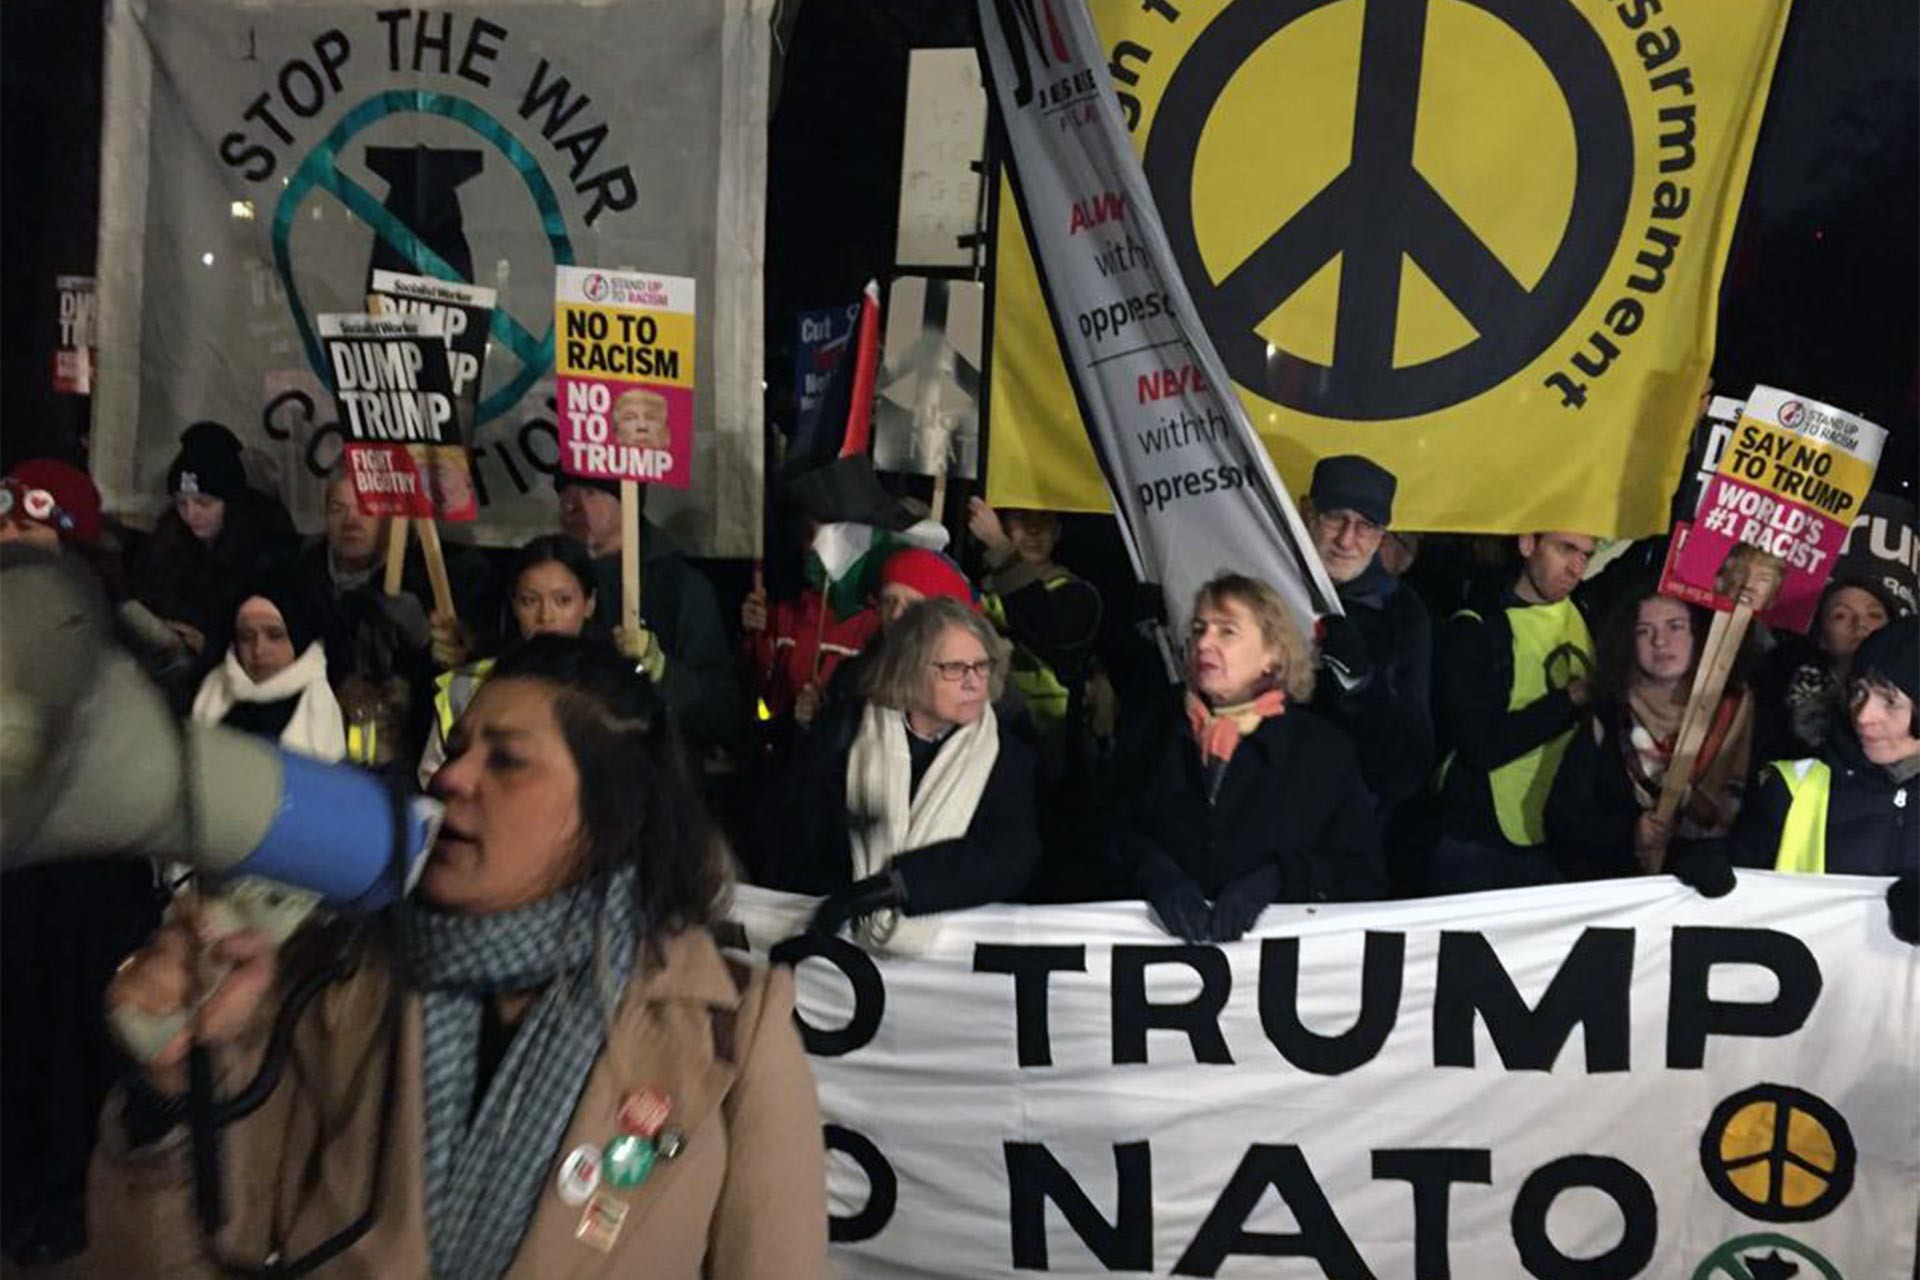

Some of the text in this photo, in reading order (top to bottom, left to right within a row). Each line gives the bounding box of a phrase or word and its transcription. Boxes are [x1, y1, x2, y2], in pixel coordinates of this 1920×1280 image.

[219, 9, 638, 227] STOP THE WAR
[1544, 0, 1696, 410] sarmament
[566, 309, 657, 345] NO TO
[329, 341, 423, 390] DUMP
[566, 340, 679, 379] RACISM
[339, 390, 450, 441] TRUMP
[566, 381, 611, 413] NO
[567, 411, 608, 442] TO
[1739, 426, 1792, 461] SAY
[1791, 445, 1832, 477] NO
[567, 440, 673, 479] TRUMP
[1732, 450, 1853, 515] TO TRUMP
[1717, 481, 1824, 545] WORLD'S
[1705, 506, 1736, 536] #1
[1739, 515, 1828, 574] RACIST
[793, 926, 1823, 1076] O TRUMP
[1003, 1139, 1658, 1280] NATO
